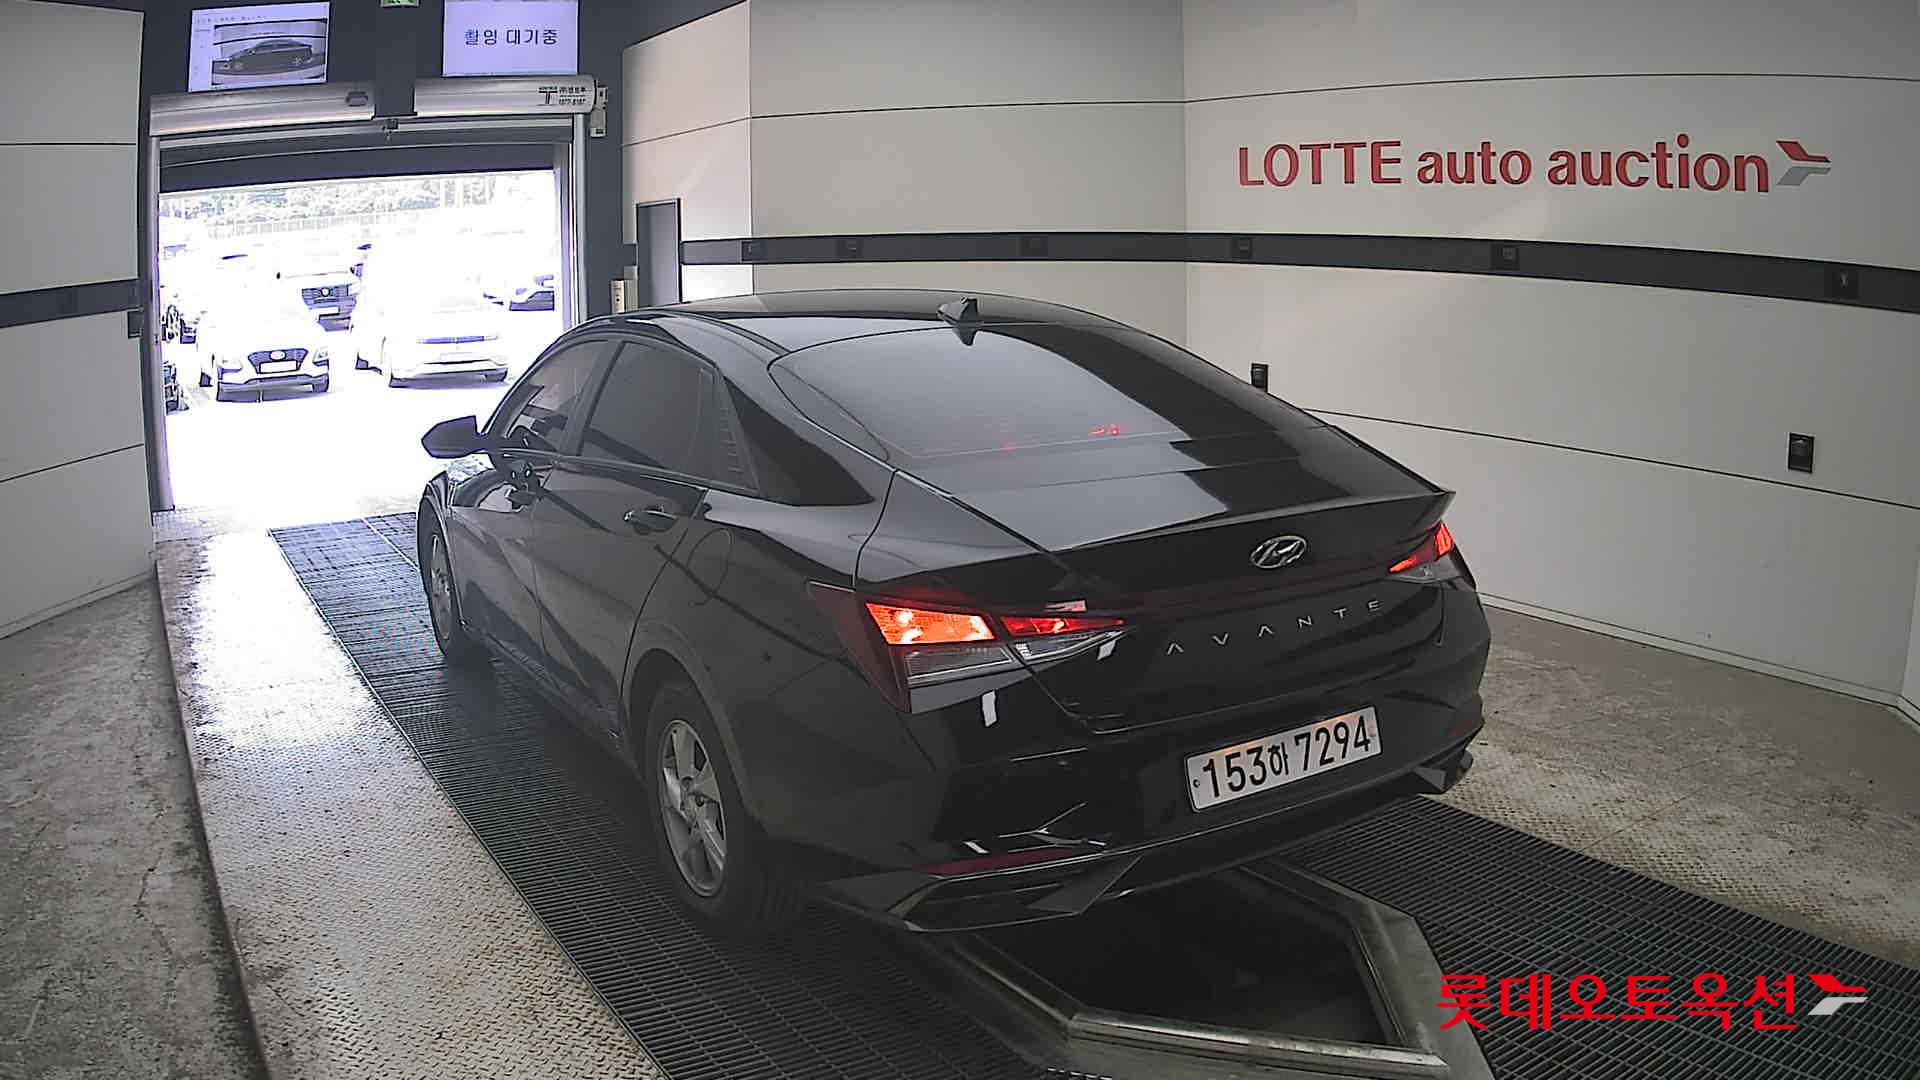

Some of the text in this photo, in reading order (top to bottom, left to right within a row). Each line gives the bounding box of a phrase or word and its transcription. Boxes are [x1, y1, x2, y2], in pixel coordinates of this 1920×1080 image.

[506, 28, 558, 45] 대기중
[1239, 134, 1769, 193] LOTTE auto auction
[1167, 600, 1380, 655] AVANTE
